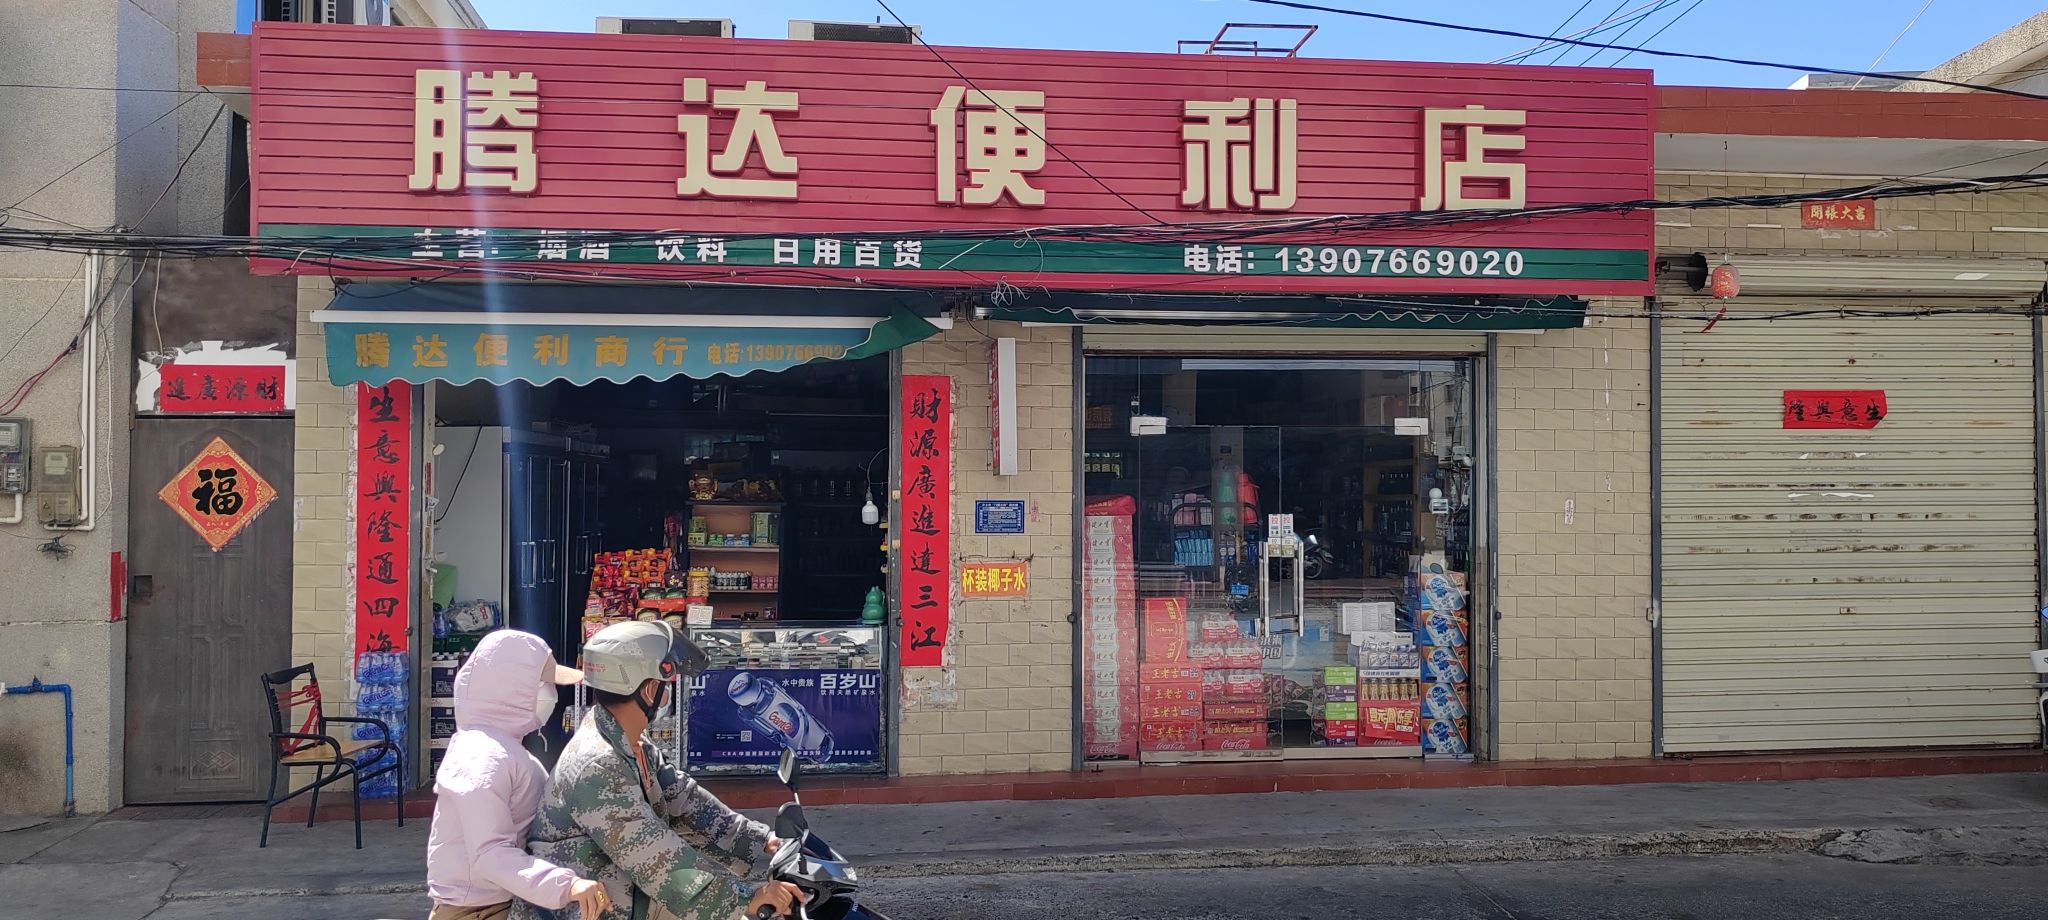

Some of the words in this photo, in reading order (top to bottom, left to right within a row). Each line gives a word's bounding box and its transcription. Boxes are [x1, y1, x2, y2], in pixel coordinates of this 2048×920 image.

[409, 69, 1527, 210] 腾达便利店
[655, 237, 728, 263] 饮料
[773, 238, 923, 268] 日用百货
[1184, 244, 1255, 273] 电话：
[1274, 247, 1524, 276] 13907669020
[354, 332, 689, 368] 腾达便利商行
[191, 467, 244, 516] 福
[962, 566, 1026, 593] 杯装椰子水
[820, 673, 876, 690] 百岁山
[1152, 668, 1181, 679] 王老吉
[1154, 688, 1184, 700] 王老吉
[1152, 707, 1181, 718] 王老吉
